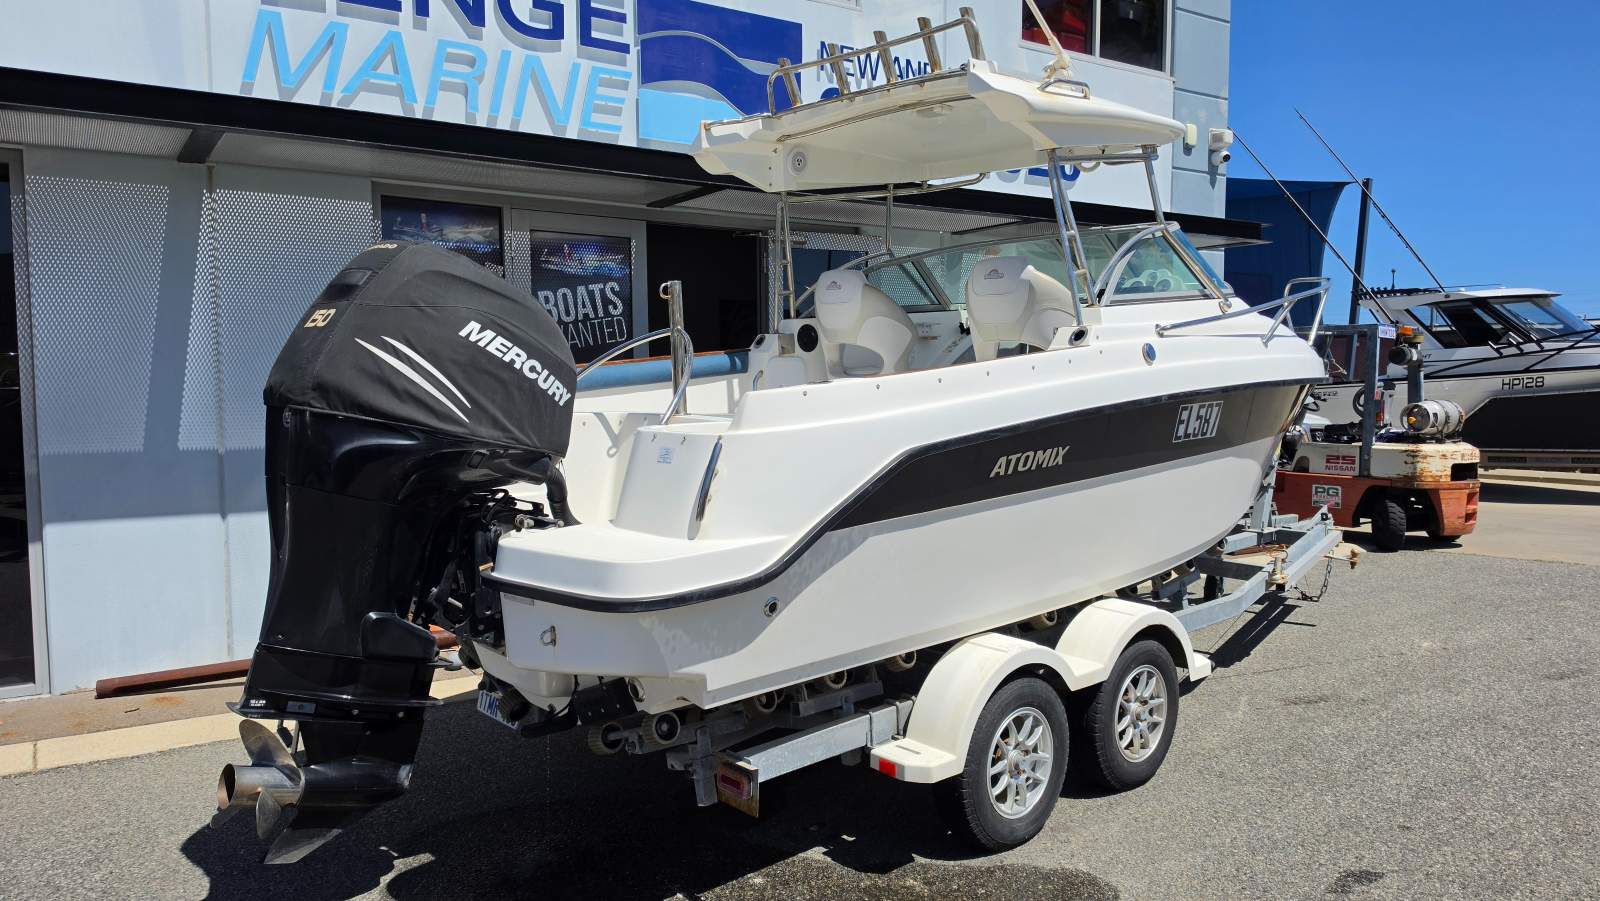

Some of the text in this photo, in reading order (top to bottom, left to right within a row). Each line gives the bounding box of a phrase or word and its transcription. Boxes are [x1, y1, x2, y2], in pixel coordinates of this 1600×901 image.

[242, 9, 633, 133] MARINE
[537, 281, 624, 322] BOATS
[560, 316, 627, 348] ANTED
[458, 321, 572, 407] MERCURY
[1501, 376, 1545, 391] HP128
[1173, 401, 1223, 442] EL587
[989, 445, 1071, 478] ATOMIX
[1314, 486, 1340, 497] PG
